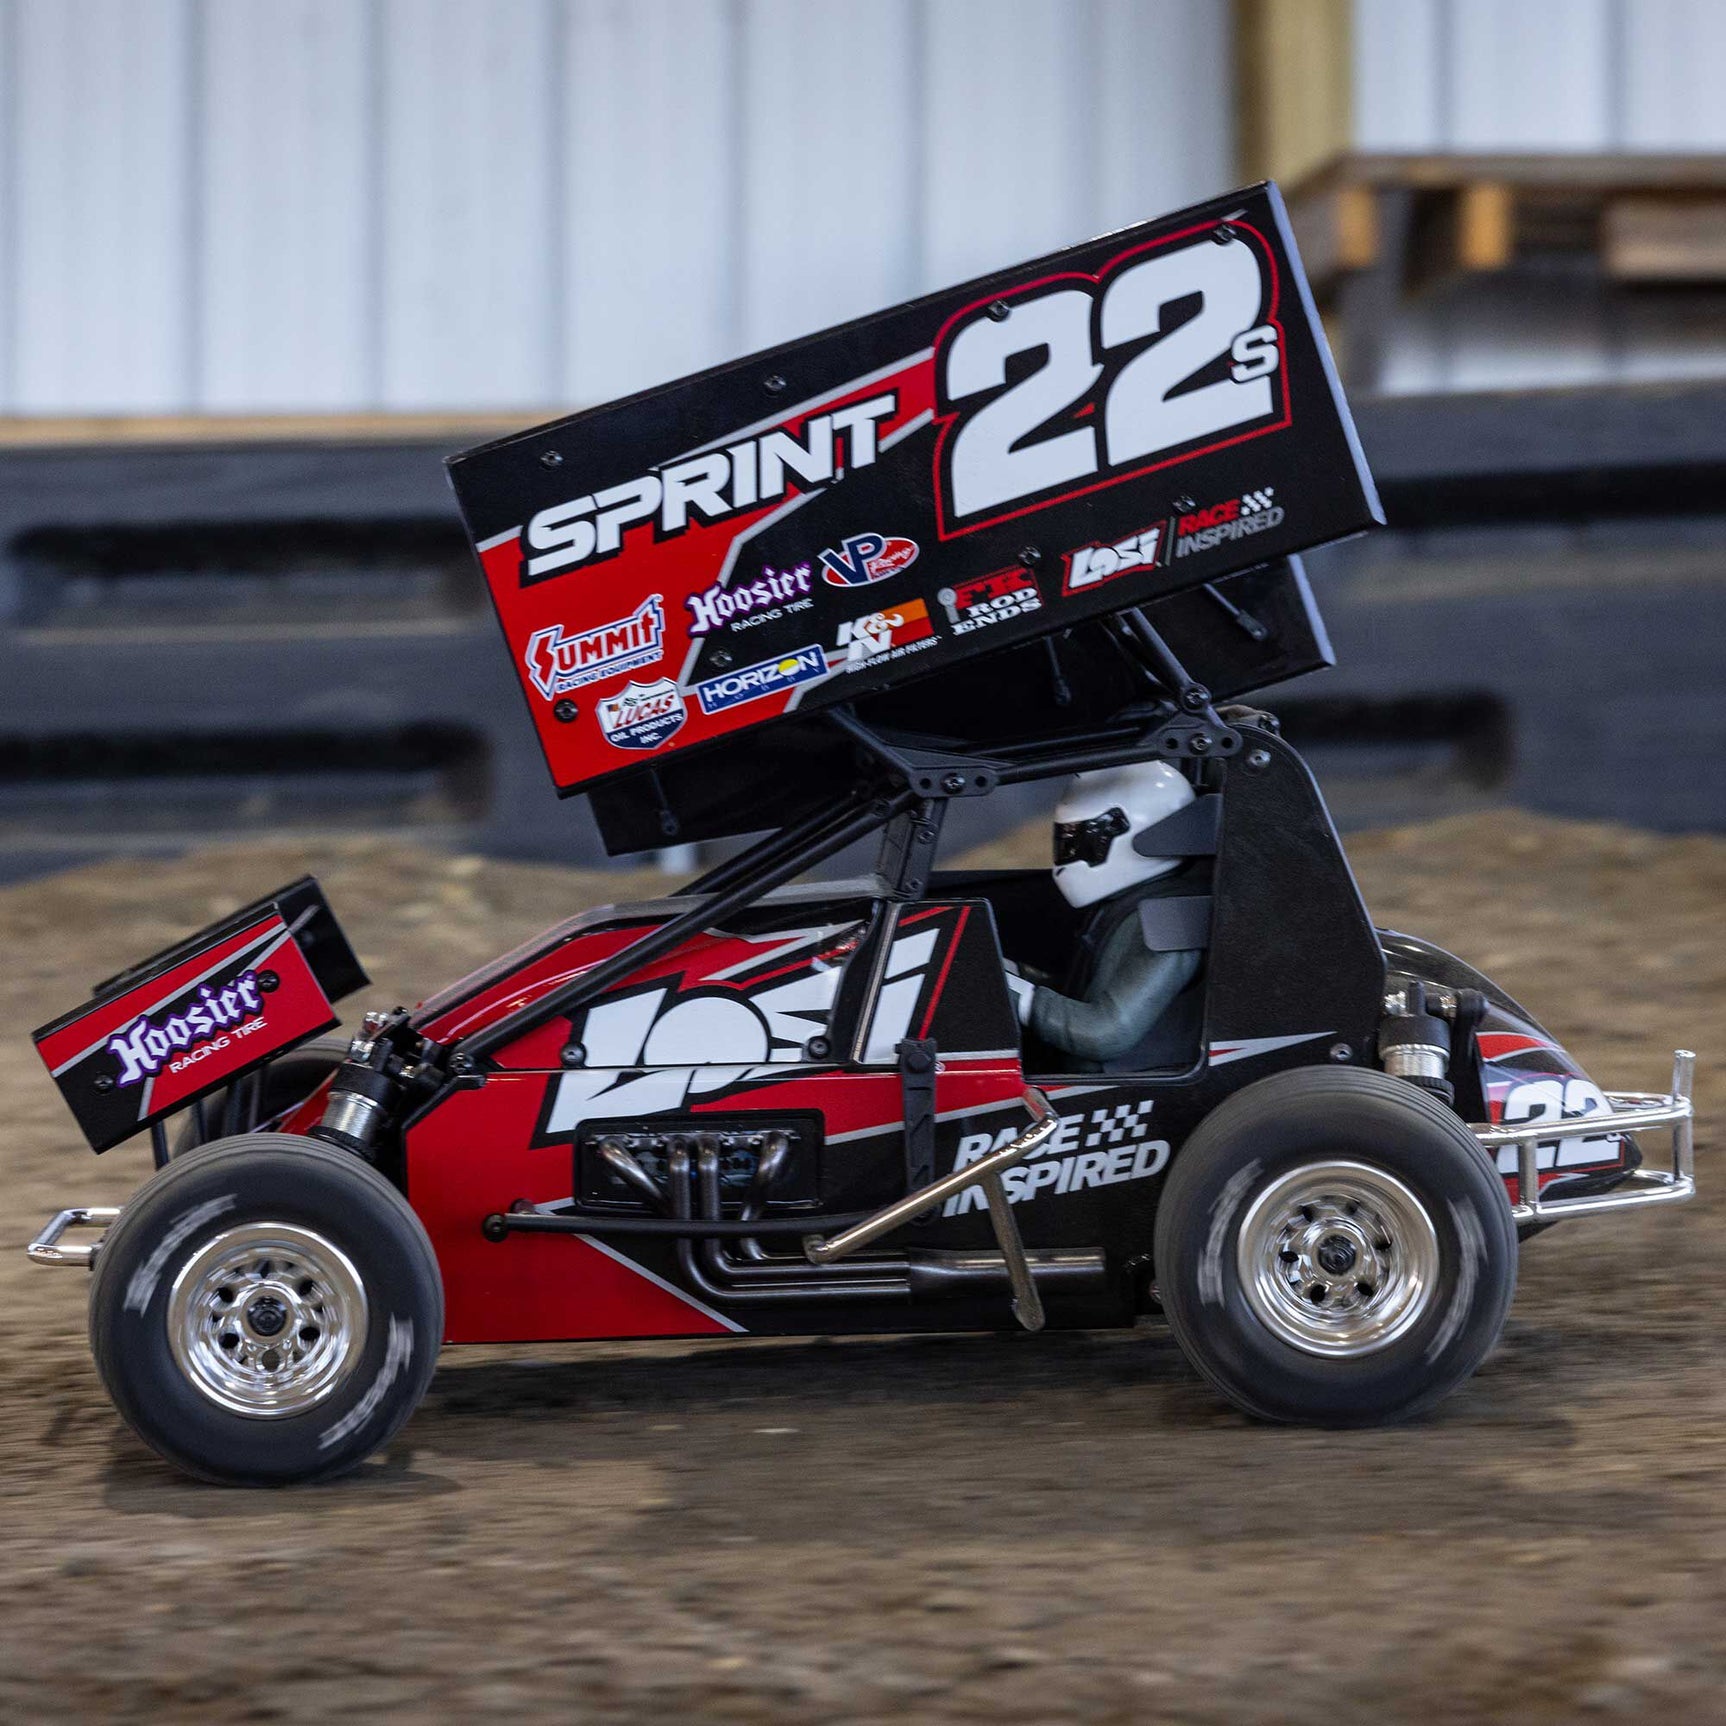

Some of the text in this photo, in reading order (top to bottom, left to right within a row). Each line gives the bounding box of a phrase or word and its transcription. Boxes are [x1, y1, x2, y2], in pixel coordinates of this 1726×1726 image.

[527, 394, 896, 577] SPRINT
[1175, 506, 1285, 558] INSPIRED
[1177, 499, 1242, 537] RACE
[817, 532, 887, 587] VP
[686, 562, 812, 635] Hoosier
[954, 568, 1034, 610] FK
[966, 587, 1038, 618] ROD
[730, 598, 815, 633] RACING TIRE
[836, 612, 905, 662] K&N
[951, 597, 1042, 636] ENDS
[556, 651, 663, 694] RACING EQUIPMENT
[702, 651, 820, 702] HORIZON
[610, 712, 685, 743] OIL PRODUCTS
[613, 694, 675, 730] LUCAS
[109, 974, 260, 1085] Hoosier
[167, 1016, 268, 1074] RACING TIRE
